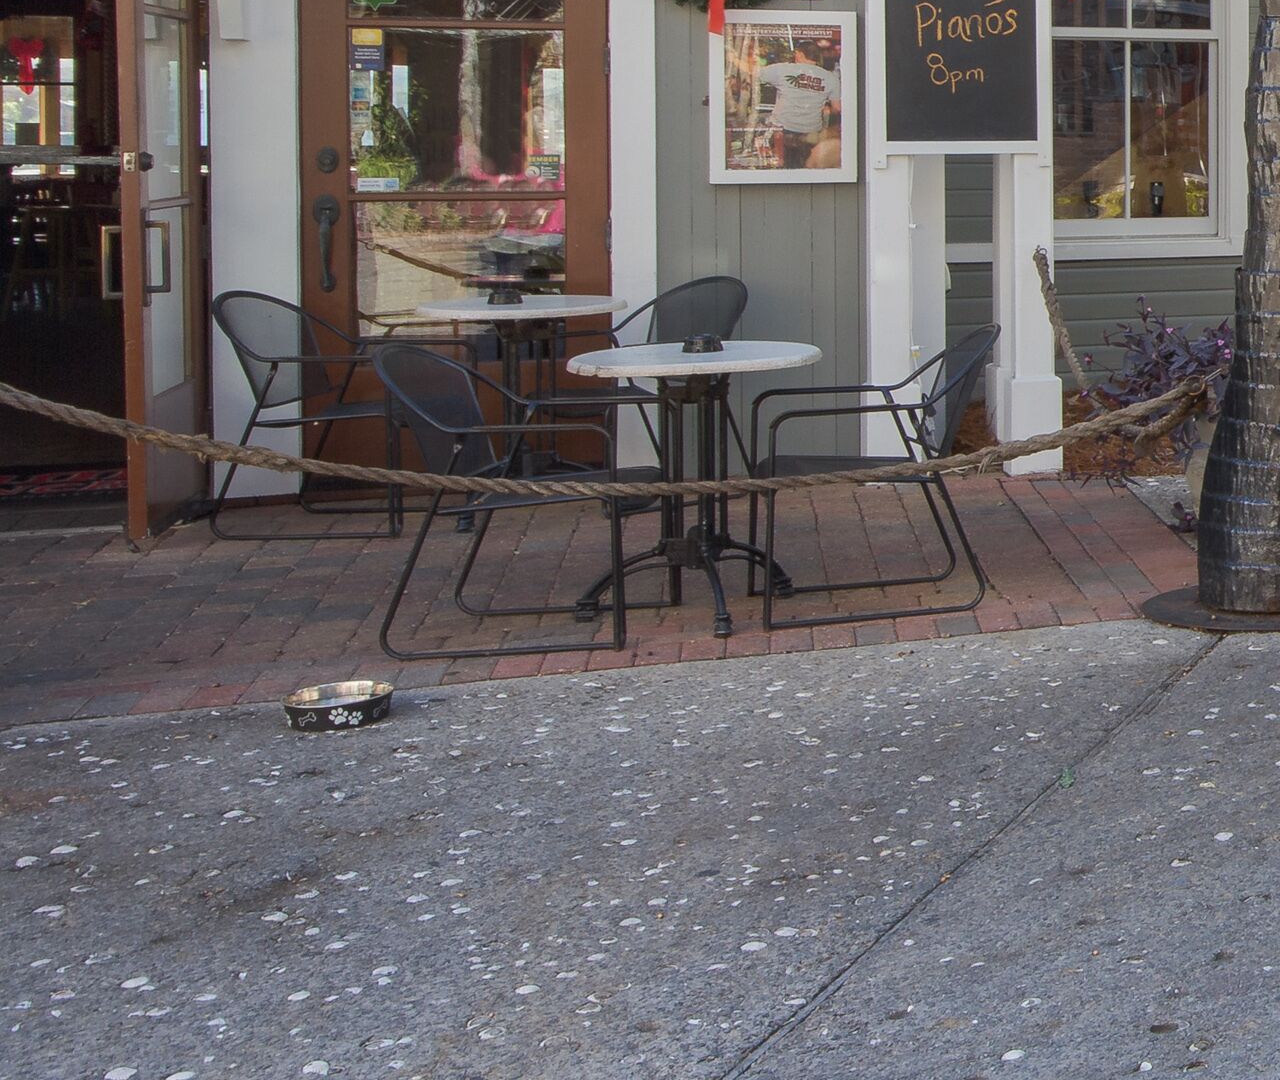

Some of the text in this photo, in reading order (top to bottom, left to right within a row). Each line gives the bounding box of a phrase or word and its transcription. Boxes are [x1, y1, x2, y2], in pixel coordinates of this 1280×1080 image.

[751, 28, 802, 37] ENTERTAINMNT
[914, 2, 1018, 47] Pianos
[926, 52, 985, 93] 8pm
